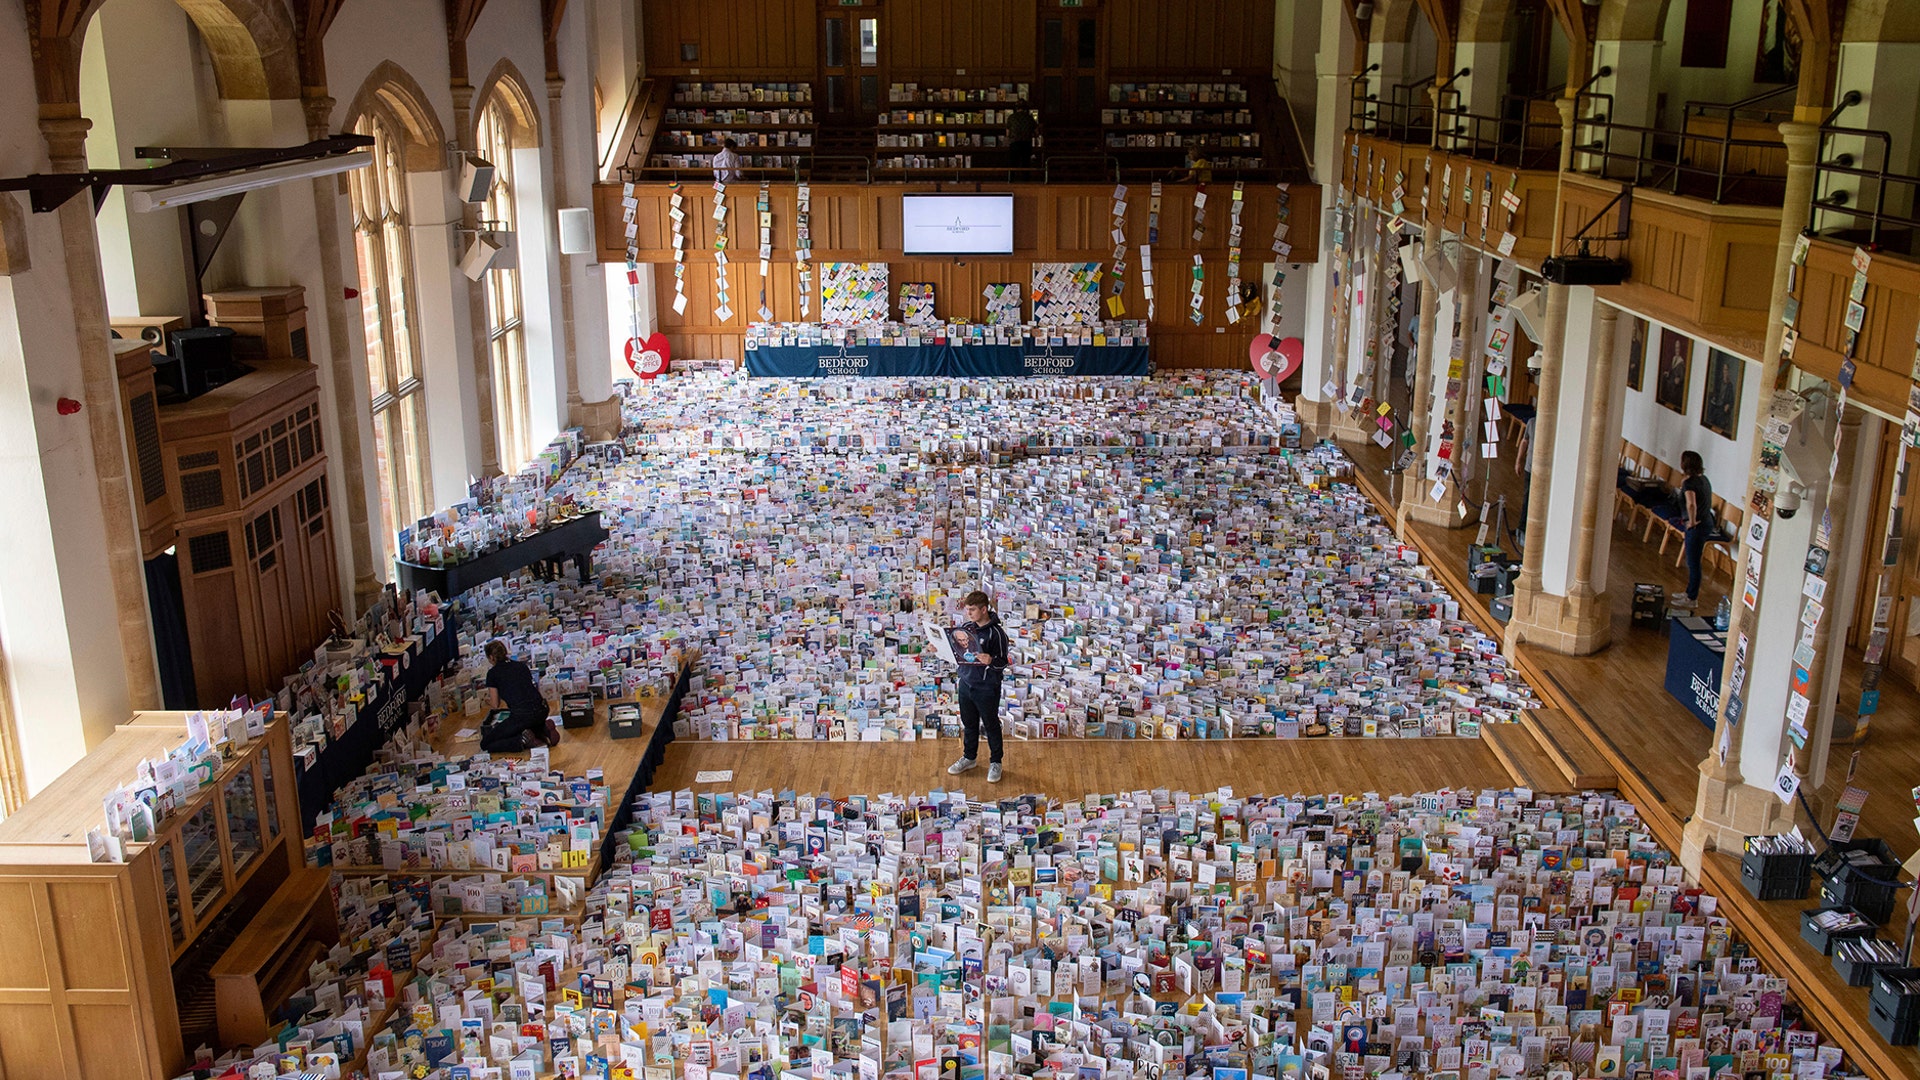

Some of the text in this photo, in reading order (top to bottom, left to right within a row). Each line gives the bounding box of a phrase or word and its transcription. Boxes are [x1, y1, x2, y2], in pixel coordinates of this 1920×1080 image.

[818, 358, 869, 368] BEDFORD
[1024, 357, 1075, 368] BEDFORD
[827, 367, 860, 375] SCHOOL
[830, 730, 843, 738] 100
[1421, 797, 1437, 810] BIG
[943, 849, 957, 857] 100
[467, 889, 480, 897] 100
[523, 897, 547, 912] 100
[1513, 934, 1528, 943] 100
[782, 976, 799, 986] 100
[1371, 1008, 1386, 1016] 100
[1503, 1057, 1519, 1065] 100
[1765, 1057, 1789, 1070] 100
